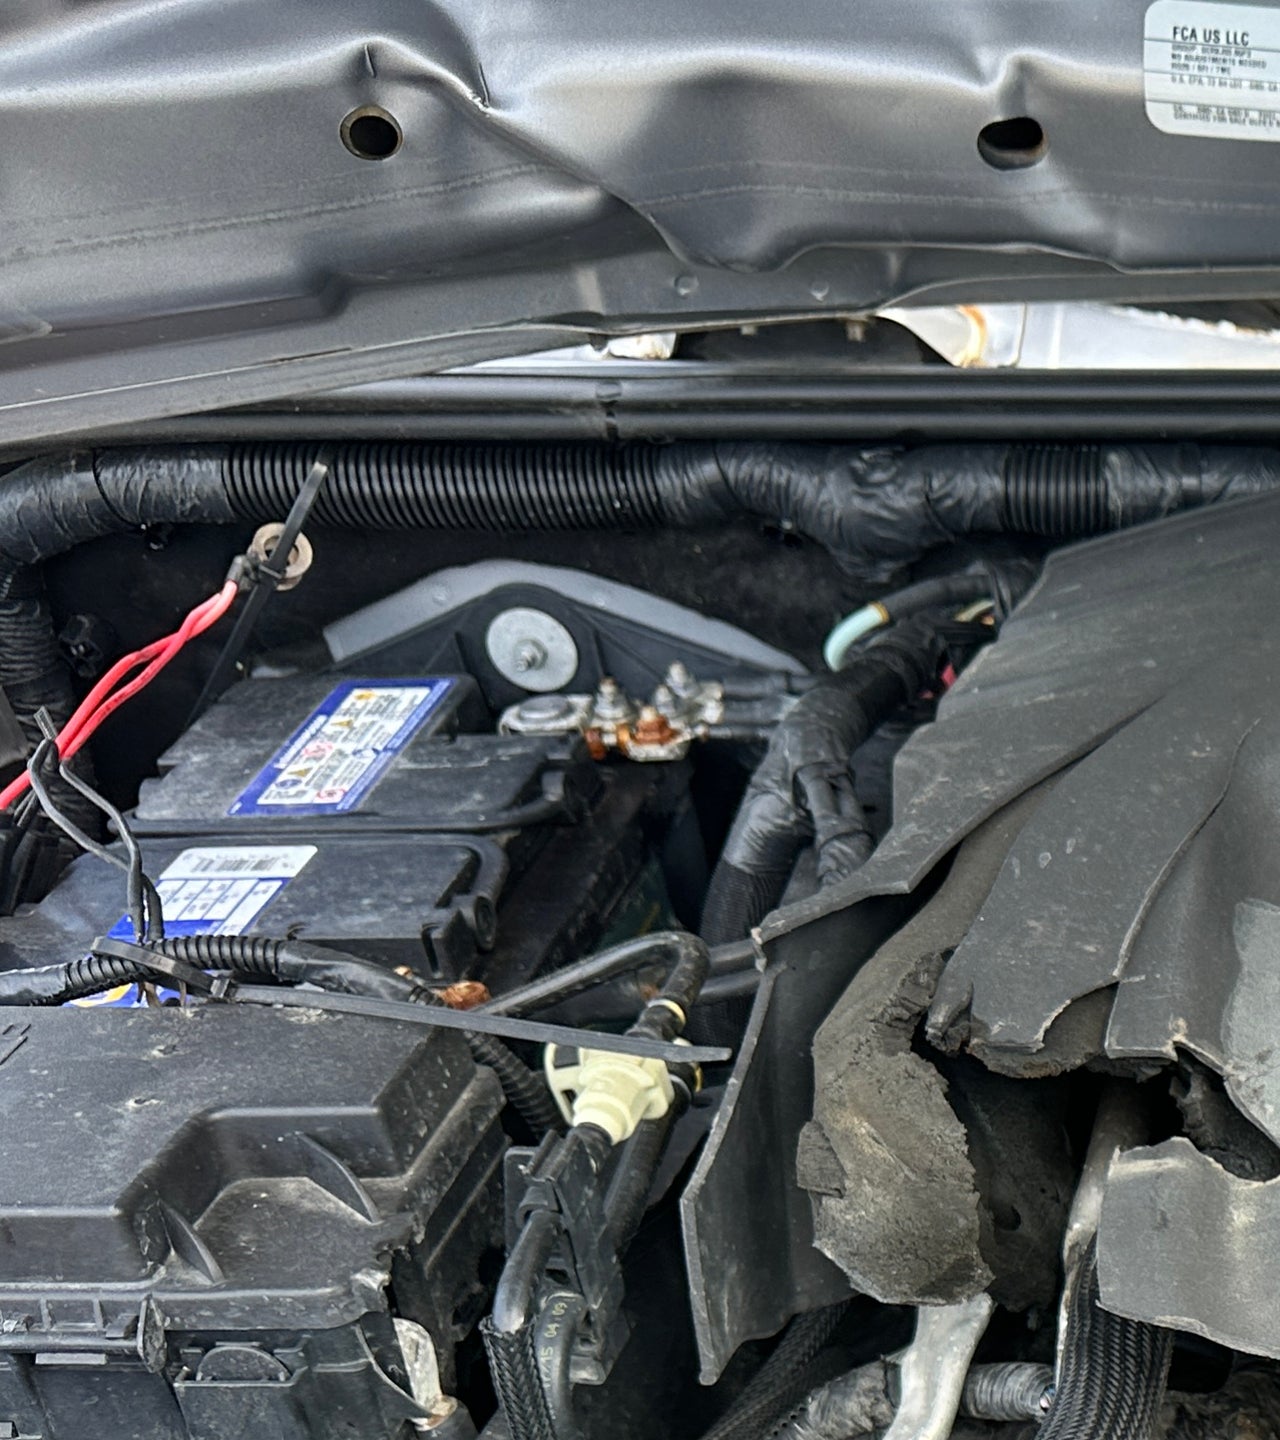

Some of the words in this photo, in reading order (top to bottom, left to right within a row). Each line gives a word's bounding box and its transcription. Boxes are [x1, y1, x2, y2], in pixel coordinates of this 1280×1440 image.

[1172, 26, 1198, 42] FCA
[1202, 28, 1221, 44] US
[1225, 31, 1250, 47] LLC
